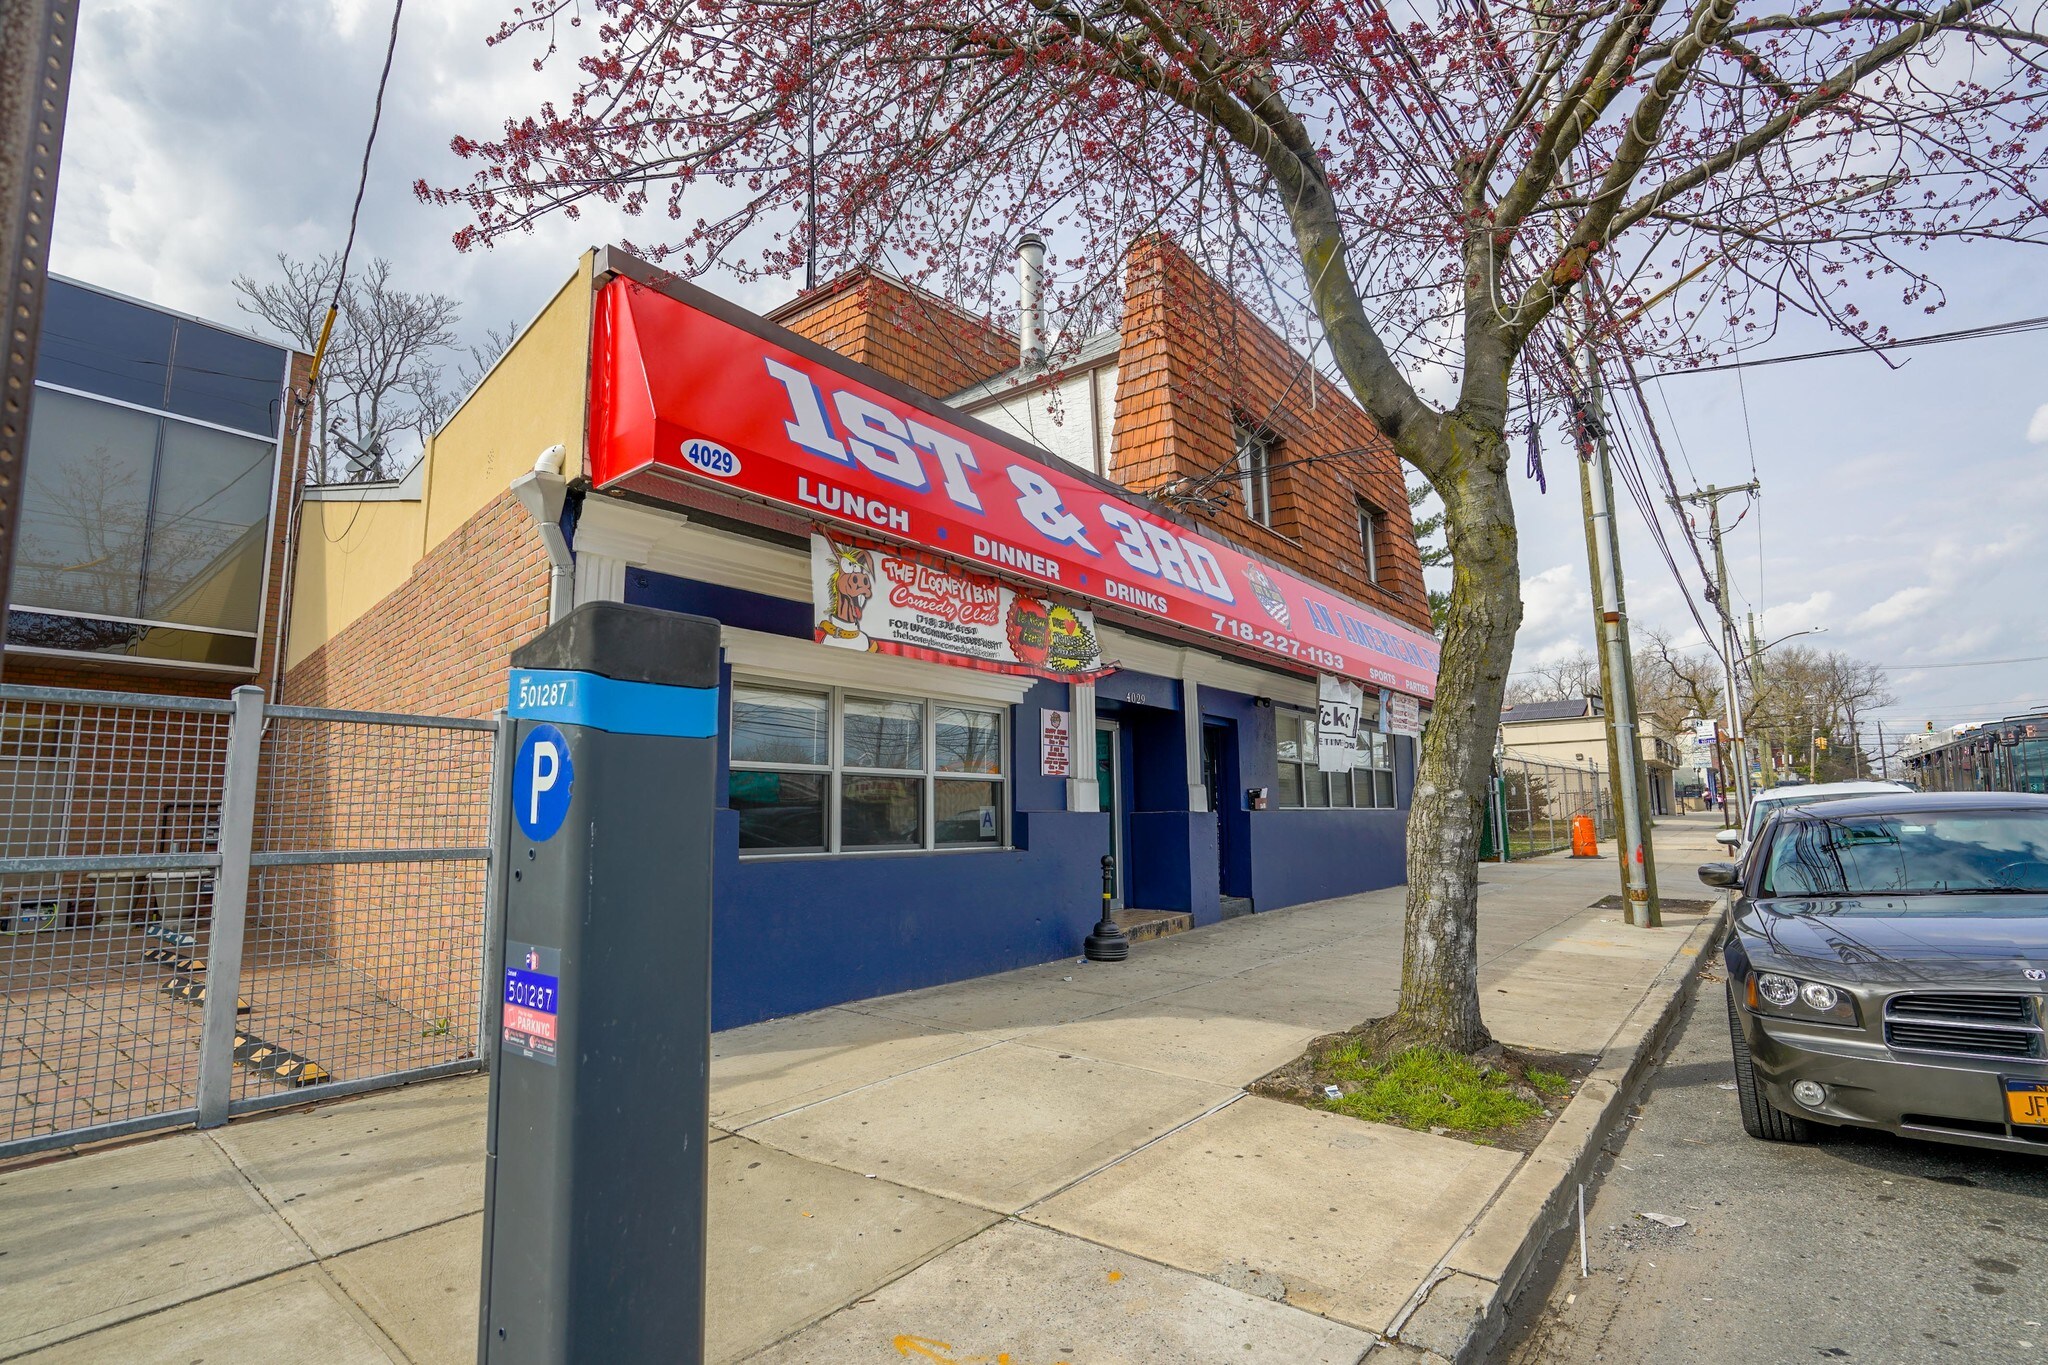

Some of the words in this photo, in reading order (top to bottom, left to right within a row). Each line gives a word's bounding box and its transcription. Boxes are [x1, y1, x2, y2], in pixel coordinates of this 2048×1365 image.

[688, 443, 733, 474] 4029
[764, 356, 985, 515] 1ST
[1005, 464, 1102, 558] &
[1099, 503, 1236, 606] 3RD
[797, 476, 909, 533] LUNCH
[973, 534, 1060, 580] DINNER
[1105, 579, 1168, 613] DRINKS
[1211, 612, 1345, 670] 718-227-1133
[1369, 667, 1396, 685] SPORTS
[1405, 679, 1429, 695] PARTIES
[885, 561, 915, 583] THE
[920, 571, 971, 602] LOONEY
[892, 587, 956, 619] Comedy
[960, 605, 996, 623] Club
[888, 618, 909, 630] FOR
[1303, 597, 1342, 638] AN
[1336, 611, 1429, 670] AMERICAN
[519, 682, 567, 708] 501287
[1126, 691, 1146, 705] 4029
[530, 741, 559, 825] P
[982, 811, 993, 828] A
[508, 980, 553, 1011] 501287
[517, 1015, 550, 1037] PARKNYC
[2024, 1095, 2048, 1117] JF
